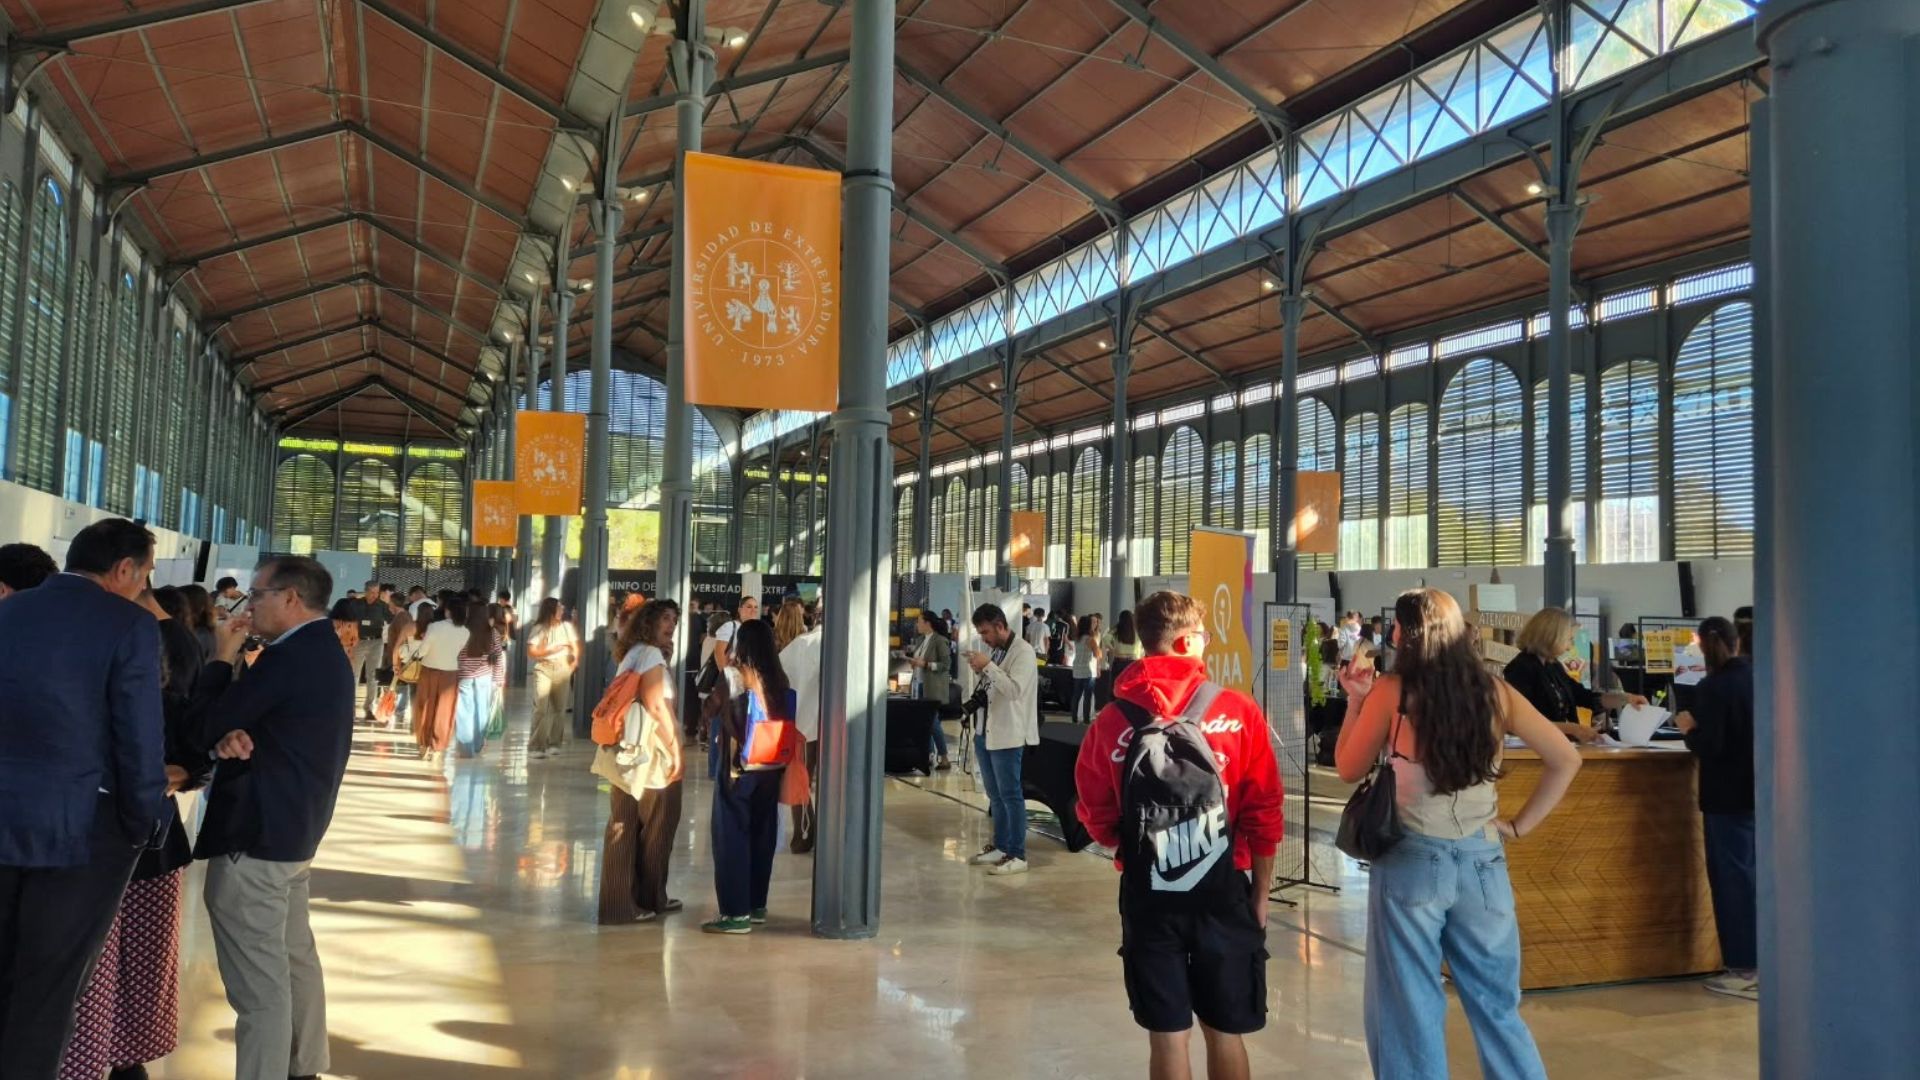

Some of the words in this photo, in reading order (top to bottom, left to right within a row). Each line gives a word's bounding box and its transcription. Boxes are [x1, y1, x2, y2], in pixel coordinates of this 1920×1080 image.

[692, 224, 740, 347] UNIVERSIDAD
[750, 221, 773, 234] DE
[784, 227, 833, 356] EXTREMADURA
[741, 351, 785, 367] 1973
[608, 580, 640, 591] NINFO
[691, 583, 741, 594] VERSIDAD
[1207, 652, 1243, 686] SIAA
[1155, 805, 1227, 873] NIKE
